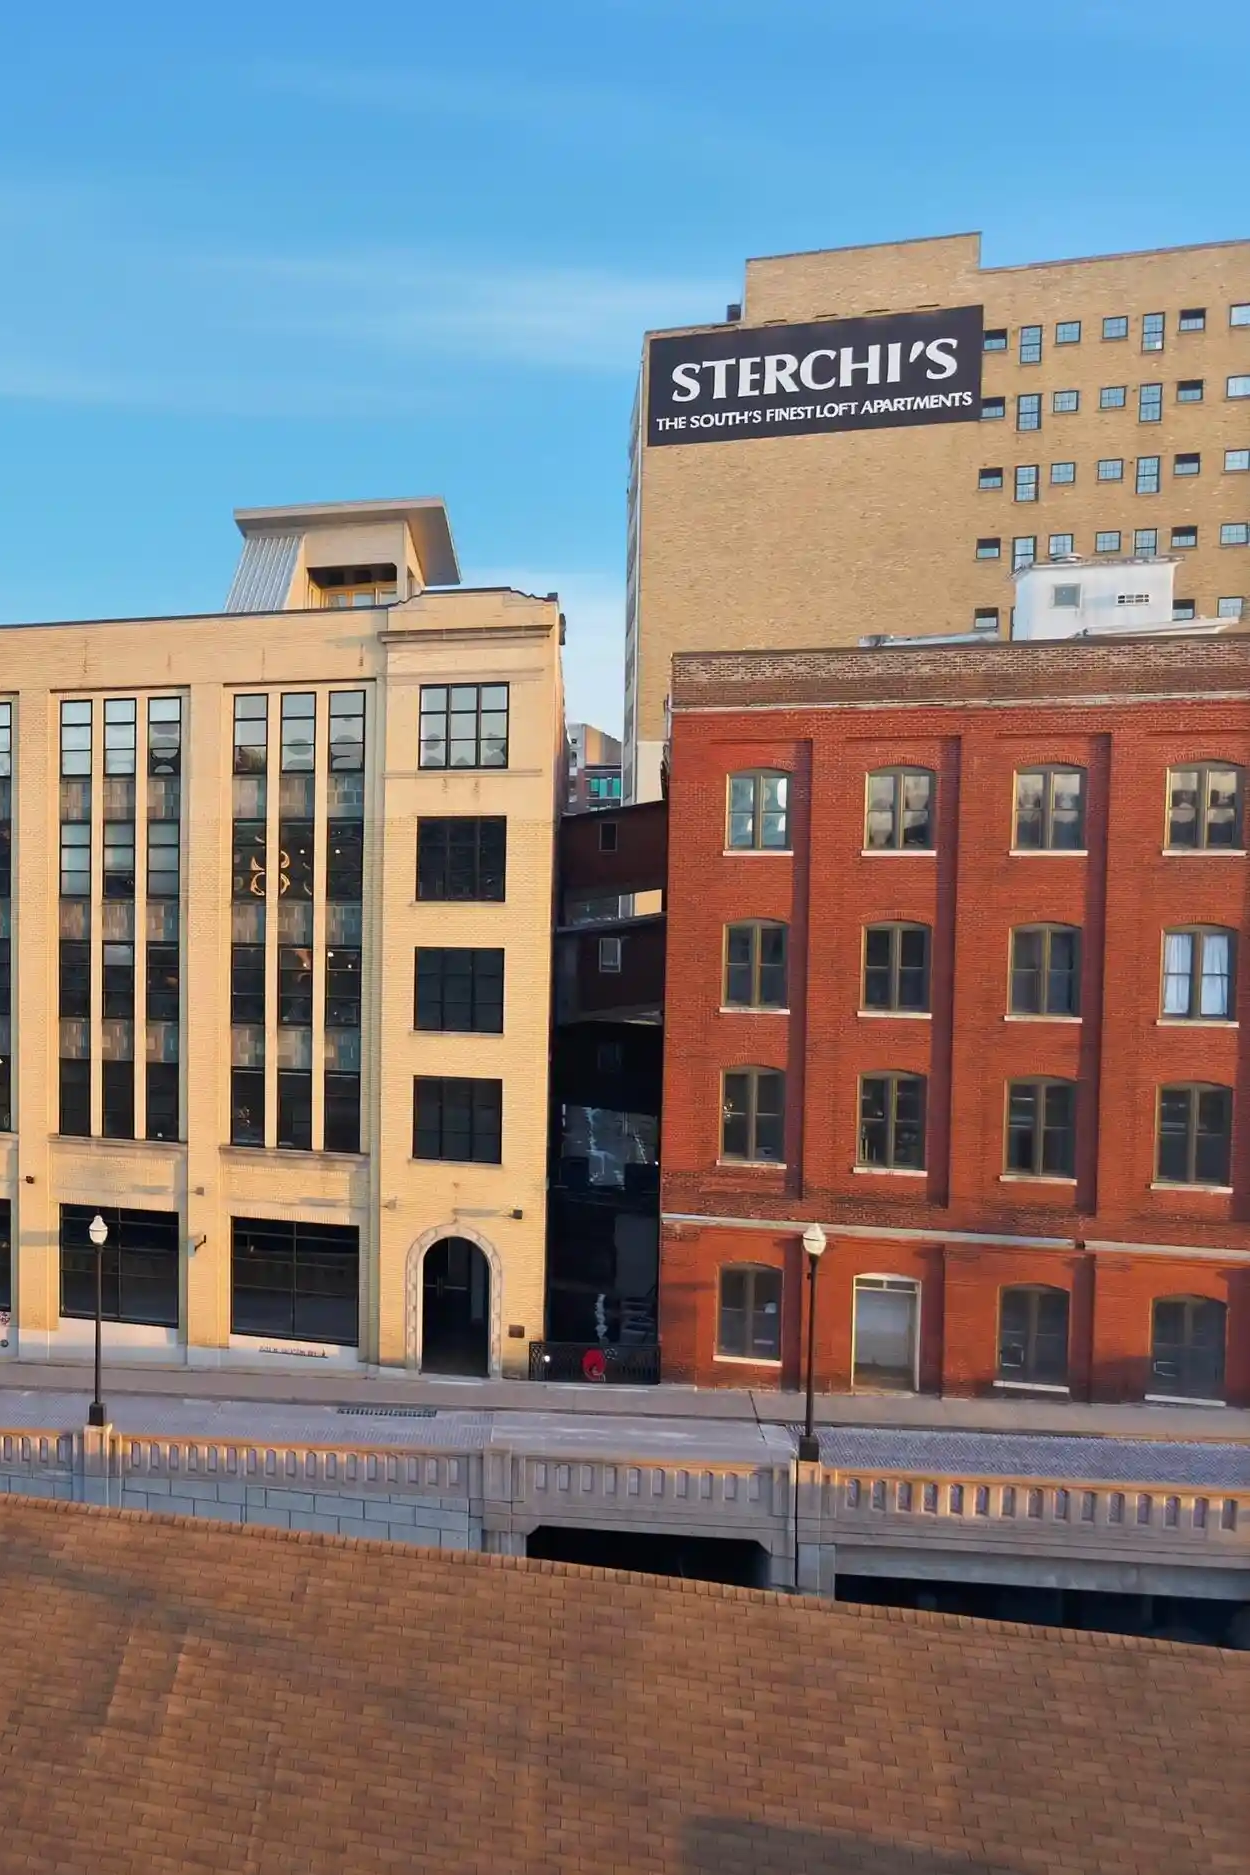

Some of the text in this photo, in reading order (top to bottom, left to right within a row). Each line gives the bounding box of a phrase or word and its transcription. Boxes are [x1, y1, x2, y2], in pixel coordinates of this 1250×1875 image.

[671, 338, 958, 402] STERCHI'S
[656, 391, 972, 431] THE SOUTH'S FINEST LOFT APARTMENTS
